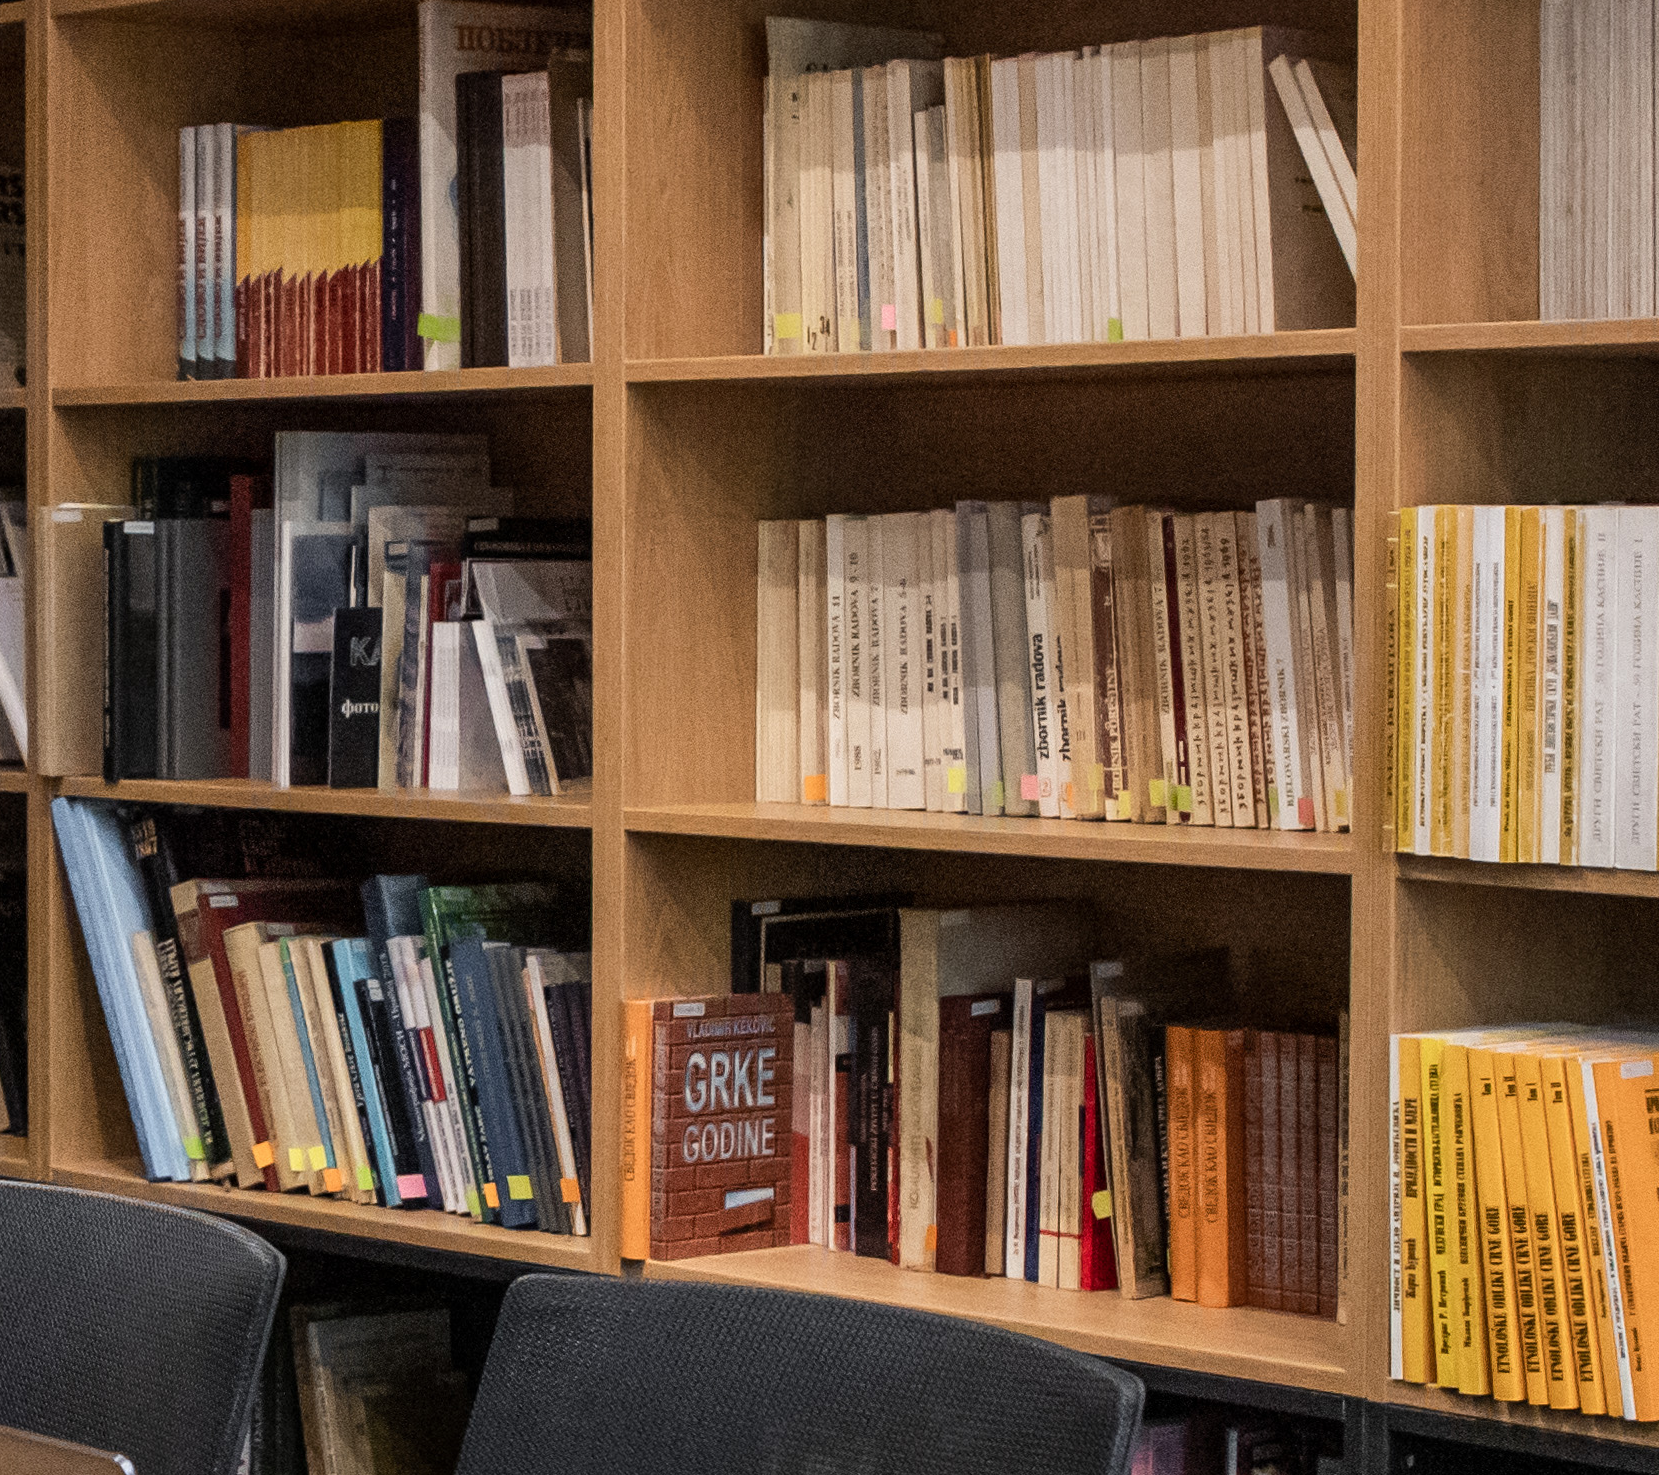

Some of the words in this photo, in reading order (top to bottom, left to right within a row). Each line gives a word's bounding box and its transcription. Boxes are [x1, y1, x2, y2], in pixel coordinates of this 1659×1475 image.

[849, 590, 861, 640] RADOVA
[869, 599, 881, 648] RADOVA
[898, 605, 909, 656] RADOVA
[1154, 600, 1167, 654] RADOVA
[831, 616, 841, 663] RADOVA
[1030, 633, 1046, 691] radova
[1595, 613, 1608, 666] ГОДИНА
[1632, 615, 1645, 668] ГОДИНА
[850, 643, 861, 698] ZBORNIK
[898, 662, 909, 715] ZBORNIK
[1032, 696, 1051, 761] zbornik
[1594, 700, 1606, 724] РАТ
[1632, 702, 1644, 726] РАТ
[1591, 800, 1604, 843] ДРУГИ
[1629, 802, 1642, 845] ДРУГИ
[684, 1047, 776, 1115] GRKE
[683, 1118, 776, 1165] GODINE
[1484, 1205, 1501, 1236] GORE
[1510, 1204, 1527, 1235] GORE
[1533, 1211, 1551, 1242] GORE
[1560, 1211, 1579, 1243] GORE
[1487, 1238, 1503, 1266] CRNE
[1514, 1237, 1530, 1266] CRNE
[1537, 1244, 1554, 1273] CRNE
[1563, 1245, 1581, 1274] CRNE
